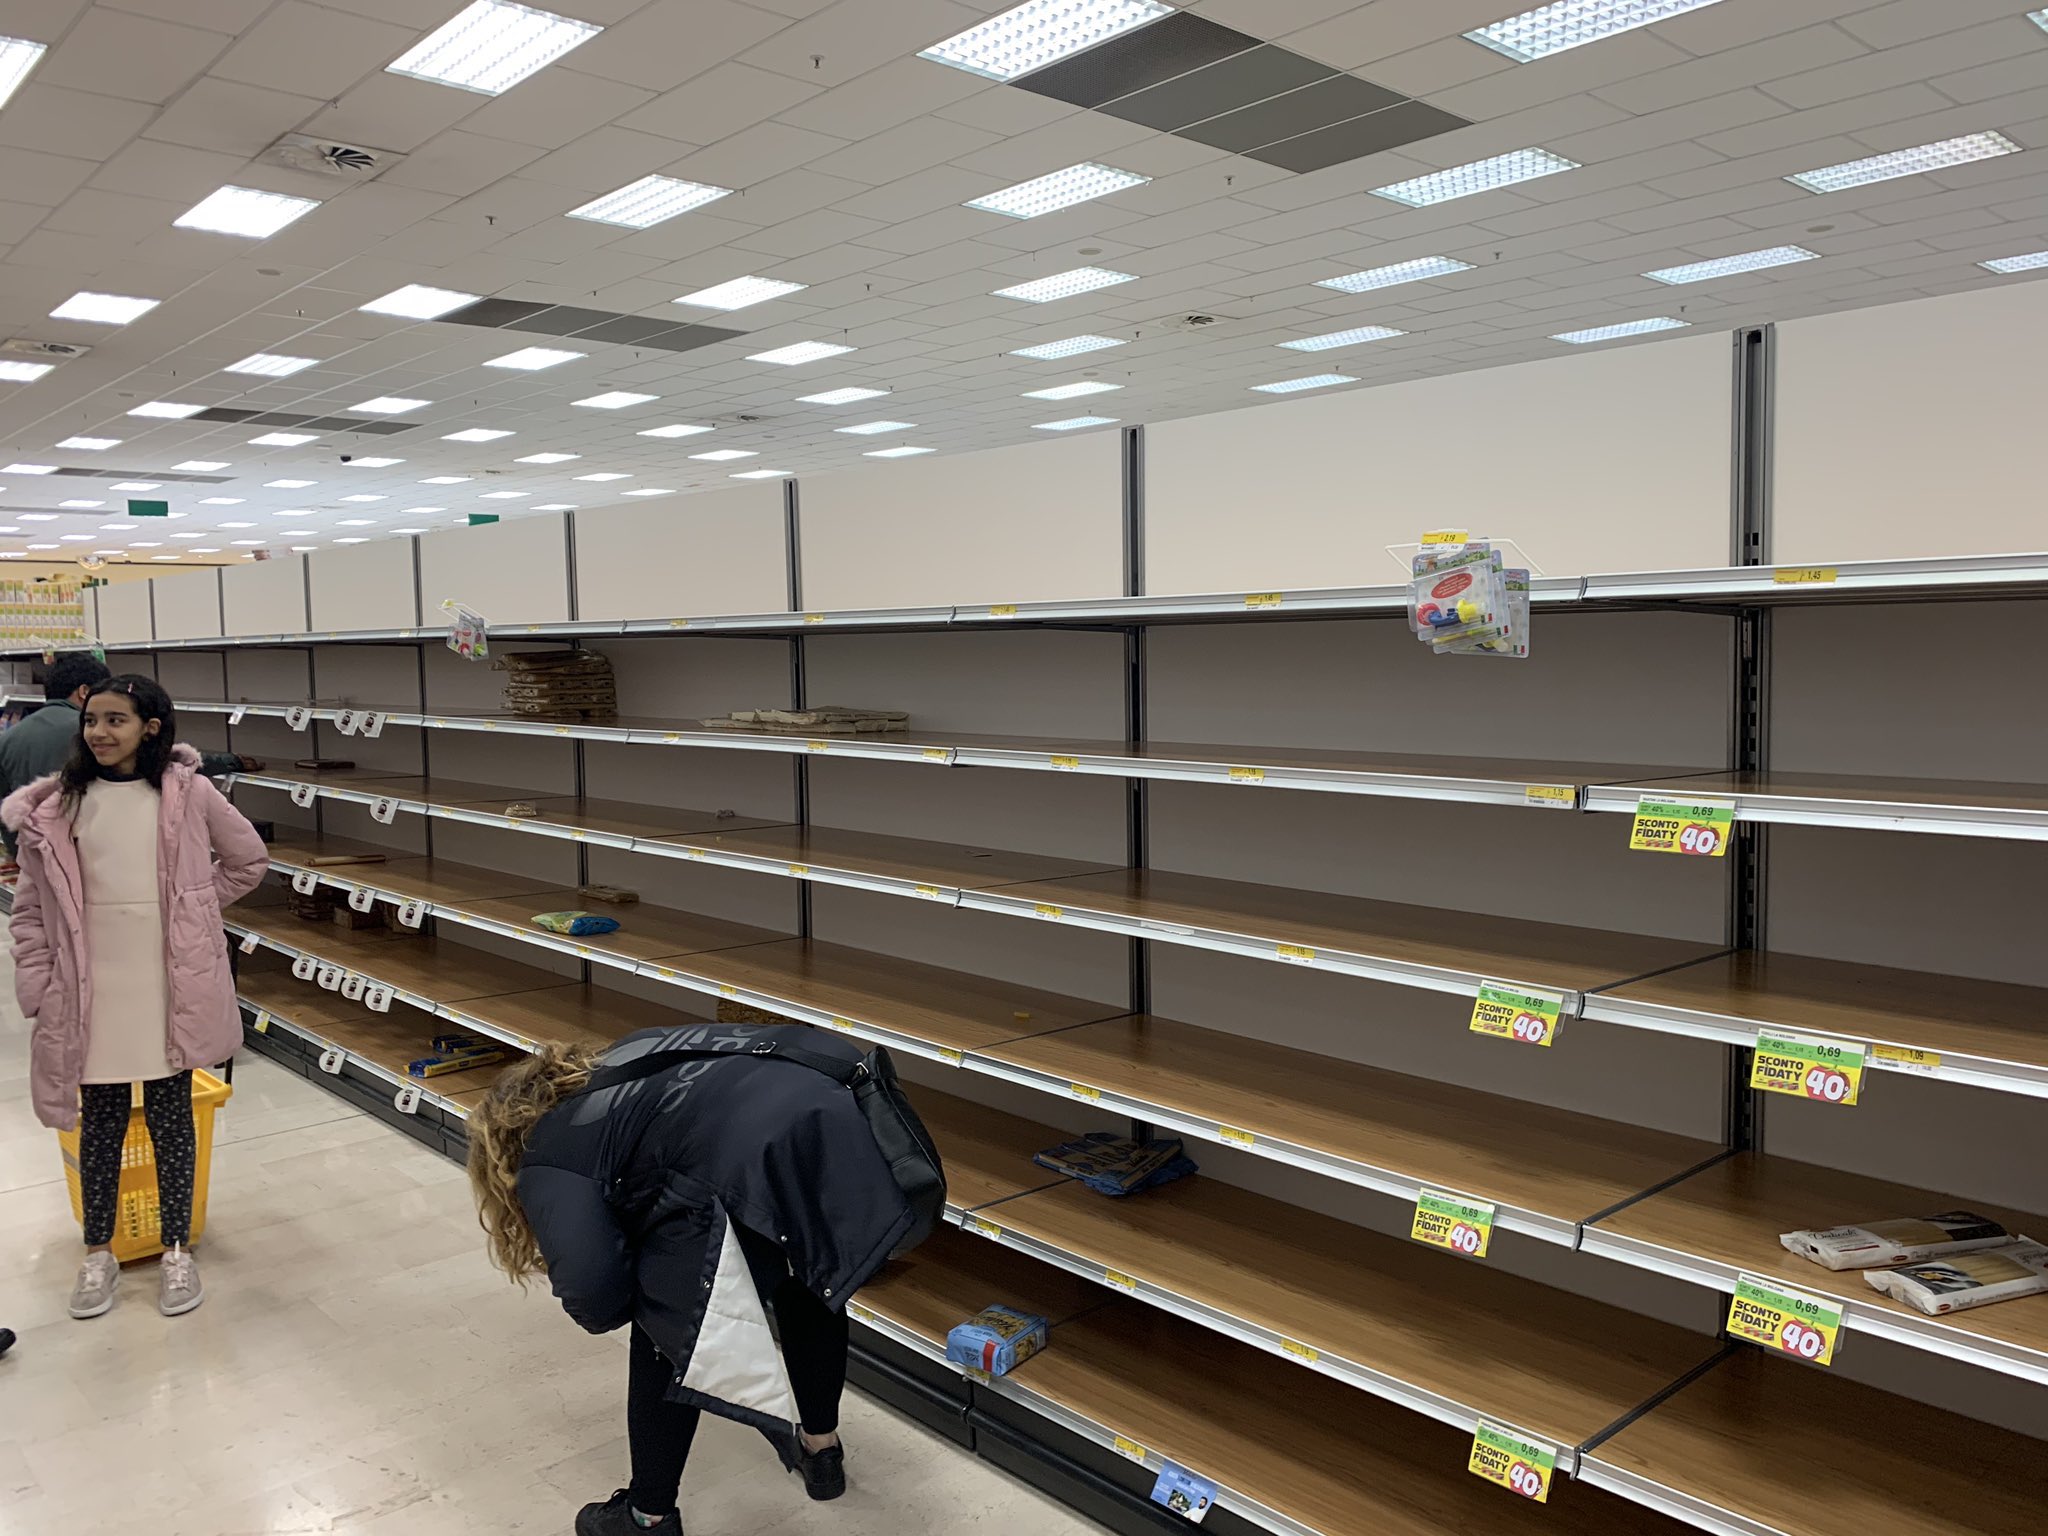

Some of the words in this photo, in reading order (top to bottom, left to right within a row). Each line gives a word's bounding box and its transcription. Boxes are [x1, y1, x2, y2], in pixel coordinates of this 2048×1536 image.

[1808, 570, 1822, 581] 1,45
[1692, 806, 1714, 817] 0,69
[1636, 818, 1680, 830] SCONTO
[1524, 996, 1544, 1008] 0,69
[1477, 1002, 1514, 1016] SCONTO
[1816, 1045, 1841, 1058] 0,69
[1909, 1049, 1924, 1061] 1,09
[1757, 1055, 1804, 1070] SCONTO
[1417, 1210, 1452, 1226] SCONTO
[1461, 1206, 1479, 1218] 0,69
[1735, 1299, 1782, 1322] SCONTO
[1795, 1299, 1819, 1315] 0,69
[1475, 1442, 1510, 1463] SCONTO
[1521, 1443, 1540, 1458] 0,69
